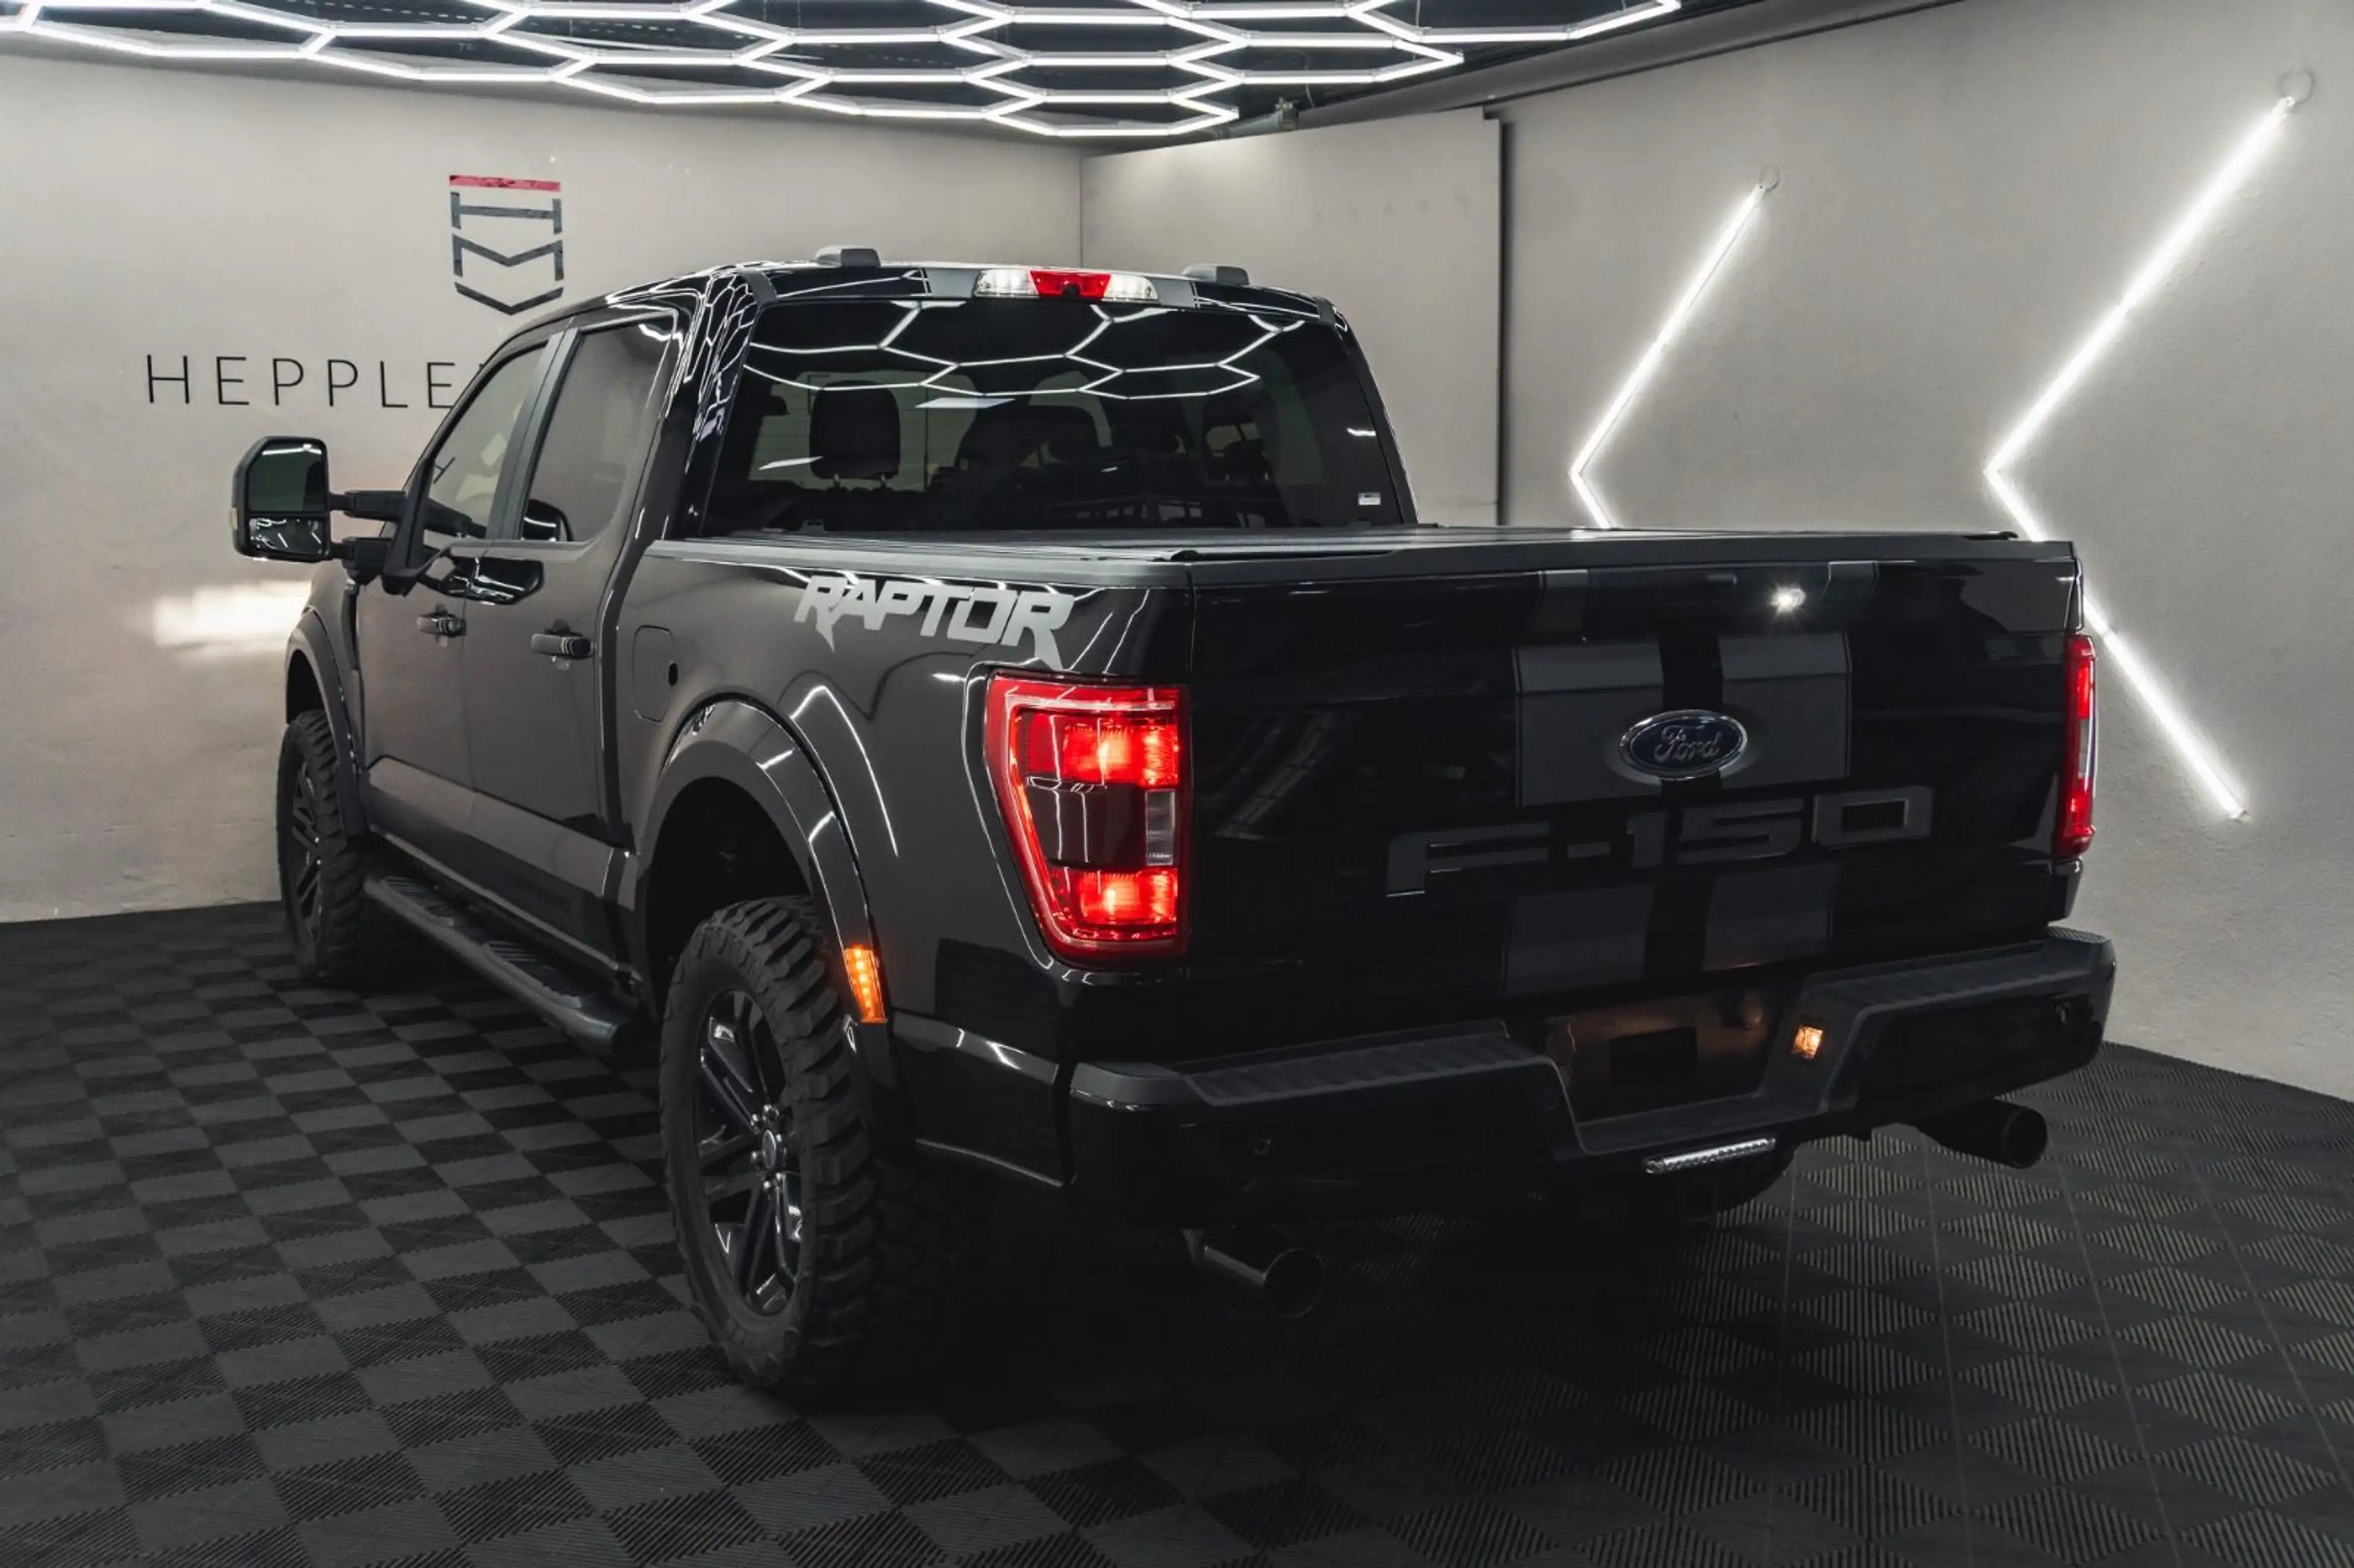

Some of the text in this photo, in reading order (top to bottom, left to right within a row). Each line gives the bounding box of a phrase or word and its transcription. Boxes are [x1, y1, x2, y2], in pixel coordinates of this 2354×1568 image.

[147, 354, 484, 409] HEPPLE
[793, 575, 1075, 670] RAPTOR
[1654, 725, 1723, 763] Ford
[1386, 786, 1933, 897] F-150
